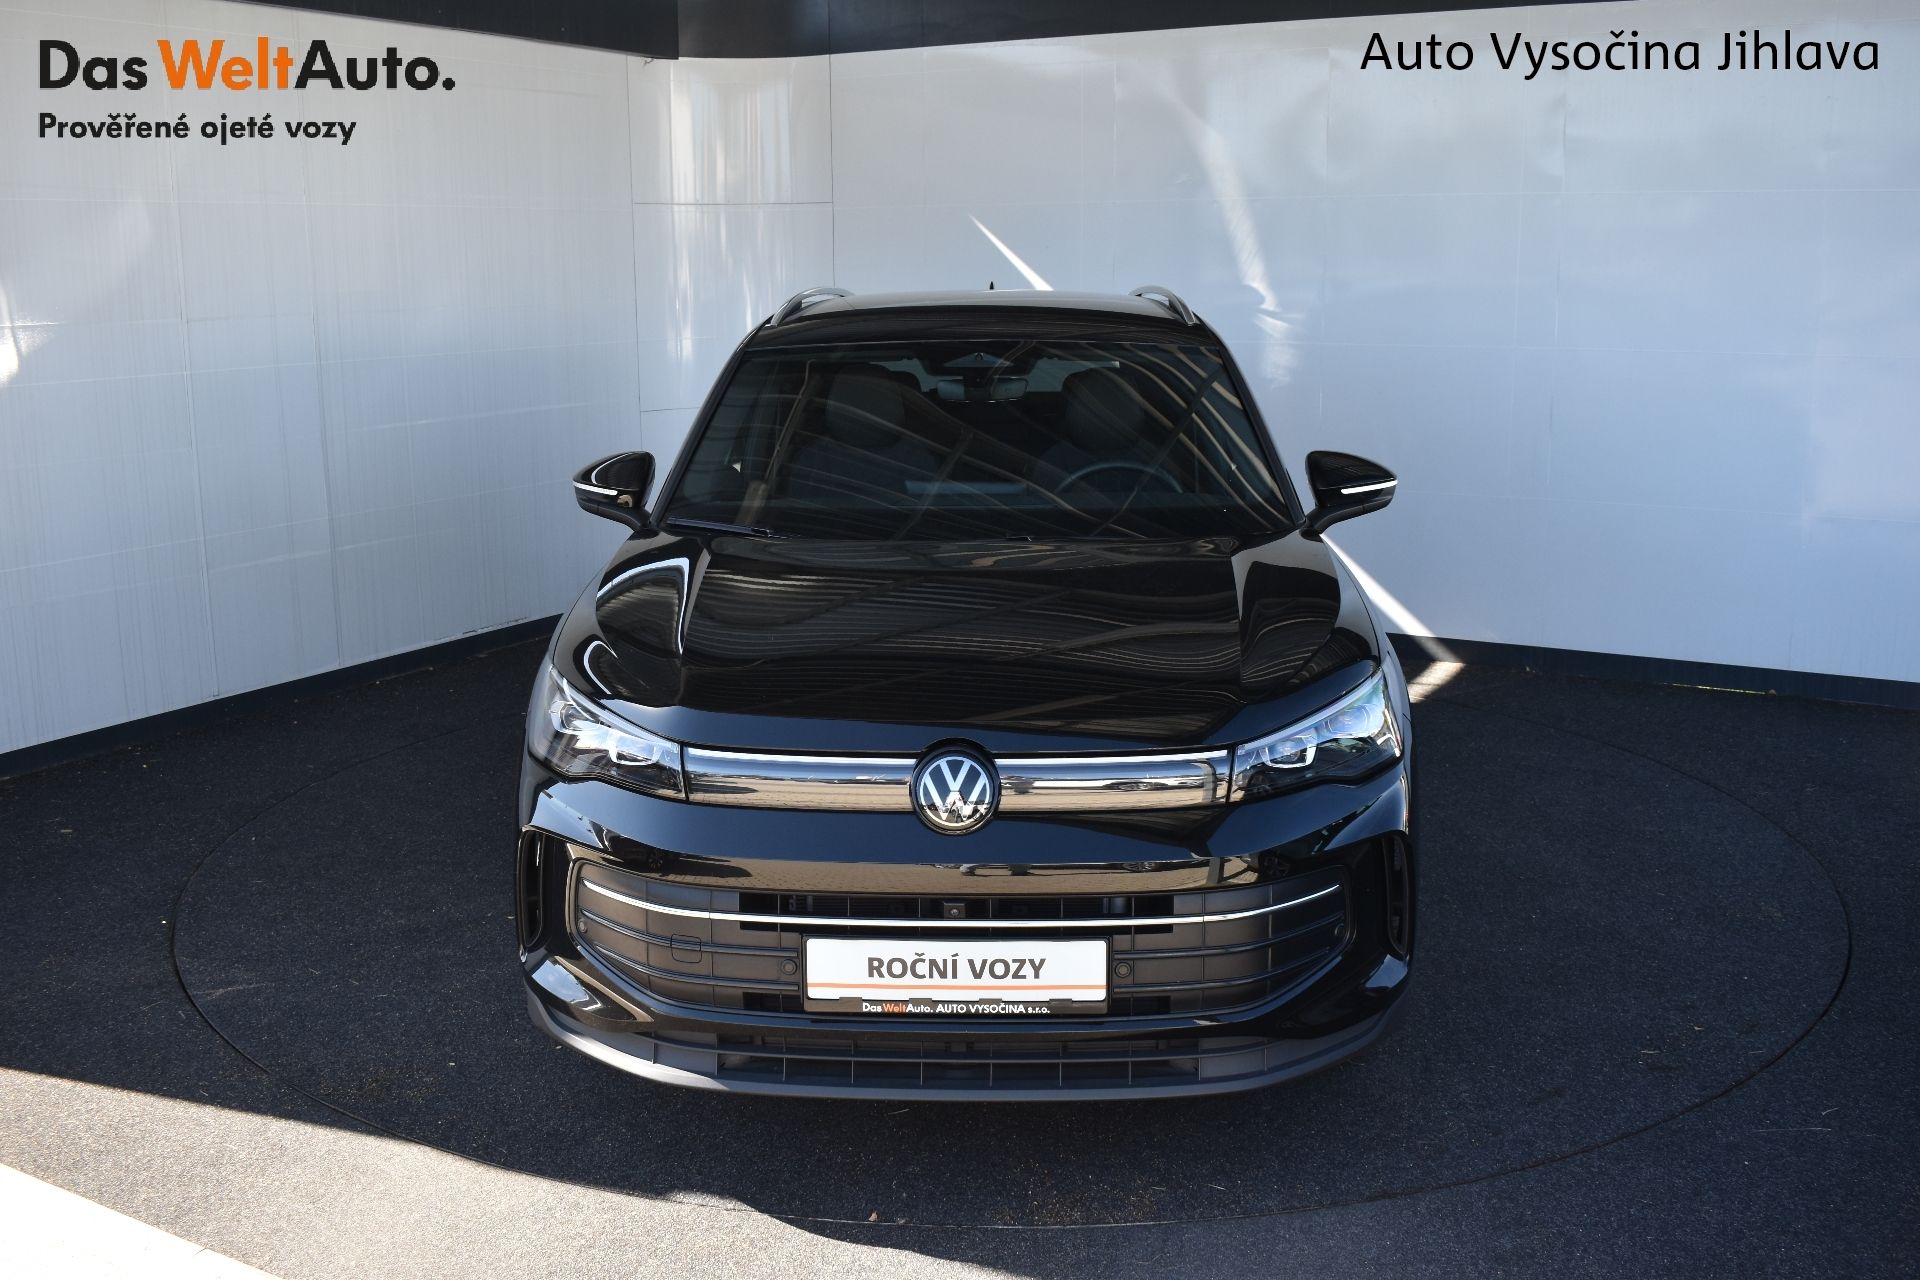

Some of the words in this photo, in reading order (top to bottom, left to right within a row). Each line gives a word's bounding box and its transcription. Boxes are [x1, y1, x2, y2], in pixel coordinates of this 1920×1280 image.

[867, 952, 959, 980] ROČNÍ
[968, 957, 1047, 980] VOZY
[935, 1003, 967, 1014] AUTO
[969, 1001, 1026, 1014] VYSOČINA
[1027, 1005, 1051, 1014] s.r.o.
